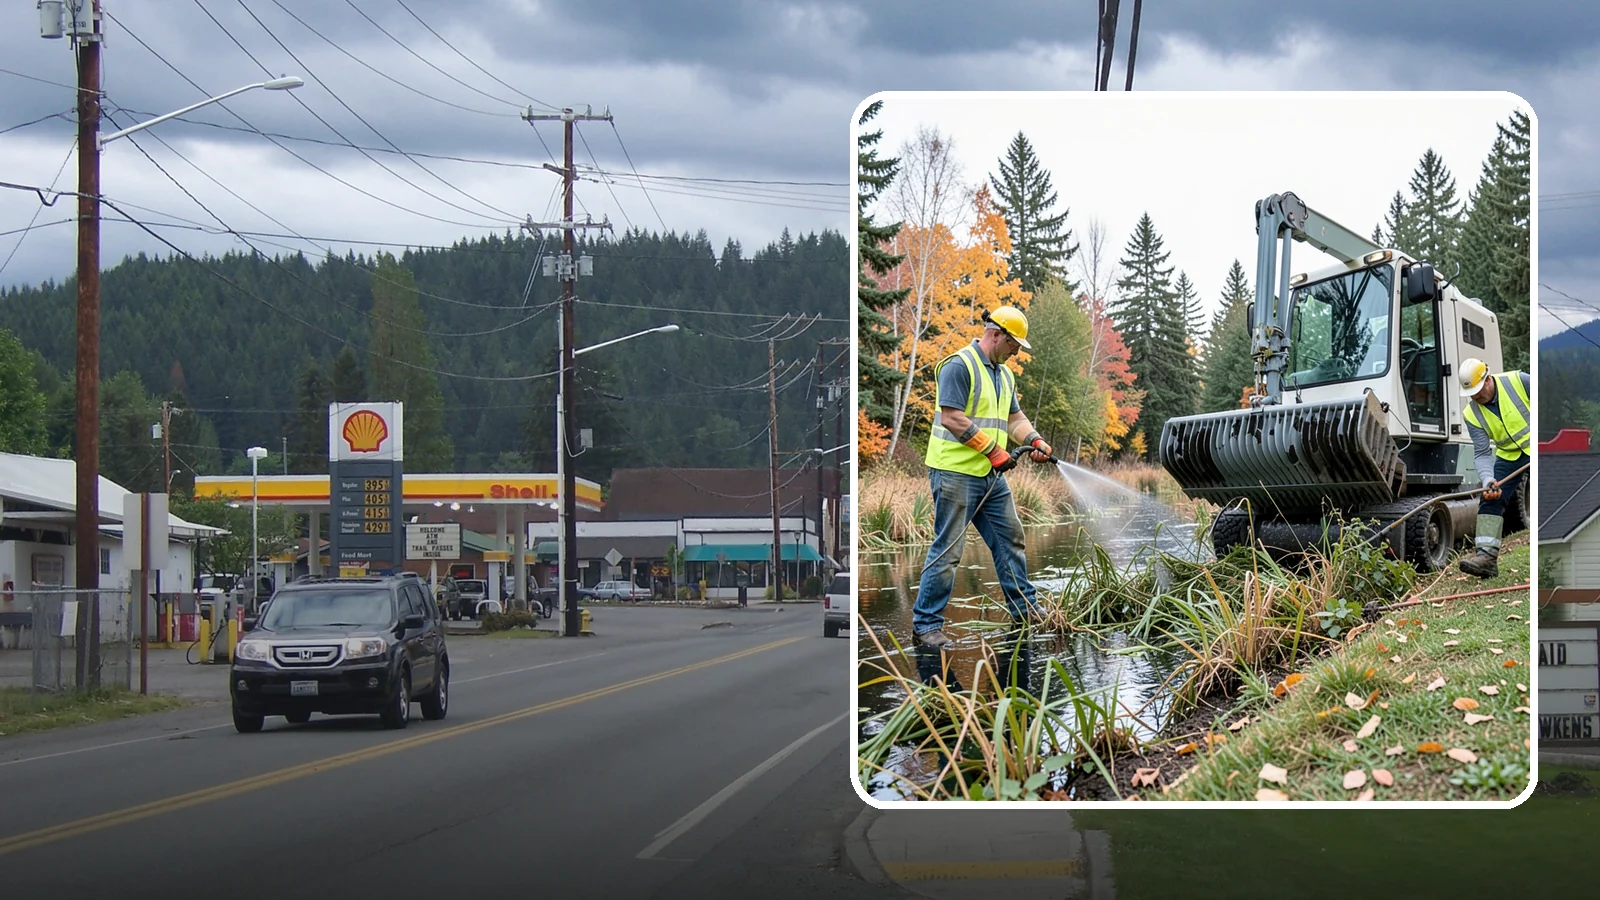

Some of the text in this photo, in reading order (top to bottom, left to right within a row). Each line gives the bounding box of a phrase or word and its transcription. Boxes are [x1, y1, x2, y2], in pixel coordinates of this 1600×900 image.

[366, 480, 384, 490] 395
[490, 484, 547, 499] Shell
[366, 495, 384, 504] 405
[366, 508, 384, 518] 415
[366, 522, 384, 532] 429
[1539, 642, 1566, 665] AID
